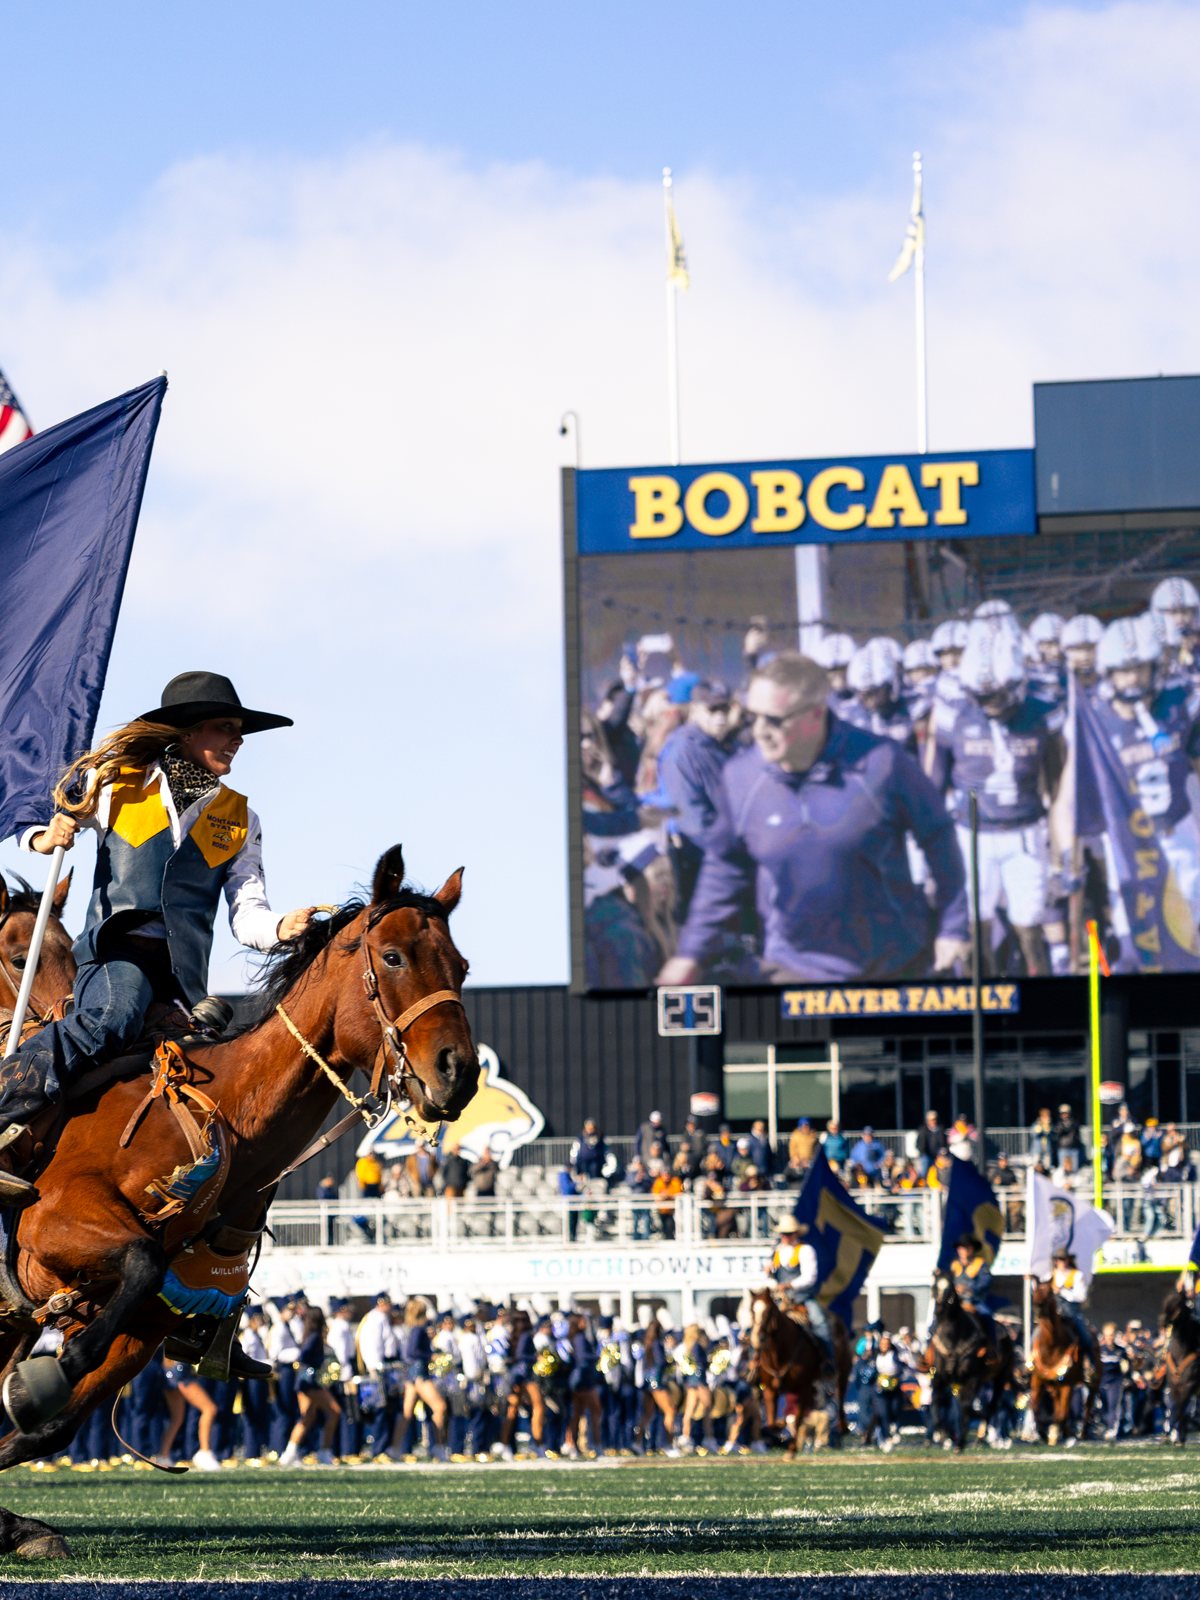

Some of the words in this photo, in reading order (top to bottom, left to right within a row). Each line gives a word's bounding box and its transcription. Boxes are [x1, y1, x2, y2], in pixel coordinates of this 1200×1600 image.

[629, 461, 978, 538] BOBCAT
[207, 814, 240, 827] MONTANA
[210, 822, 236, 833] STATE
[783, 989, 903, 1016] THAYER
[906, 985, 1017, 1012] FAMILY
[528, 1256, 712, 1277] TOUCHDOWN
